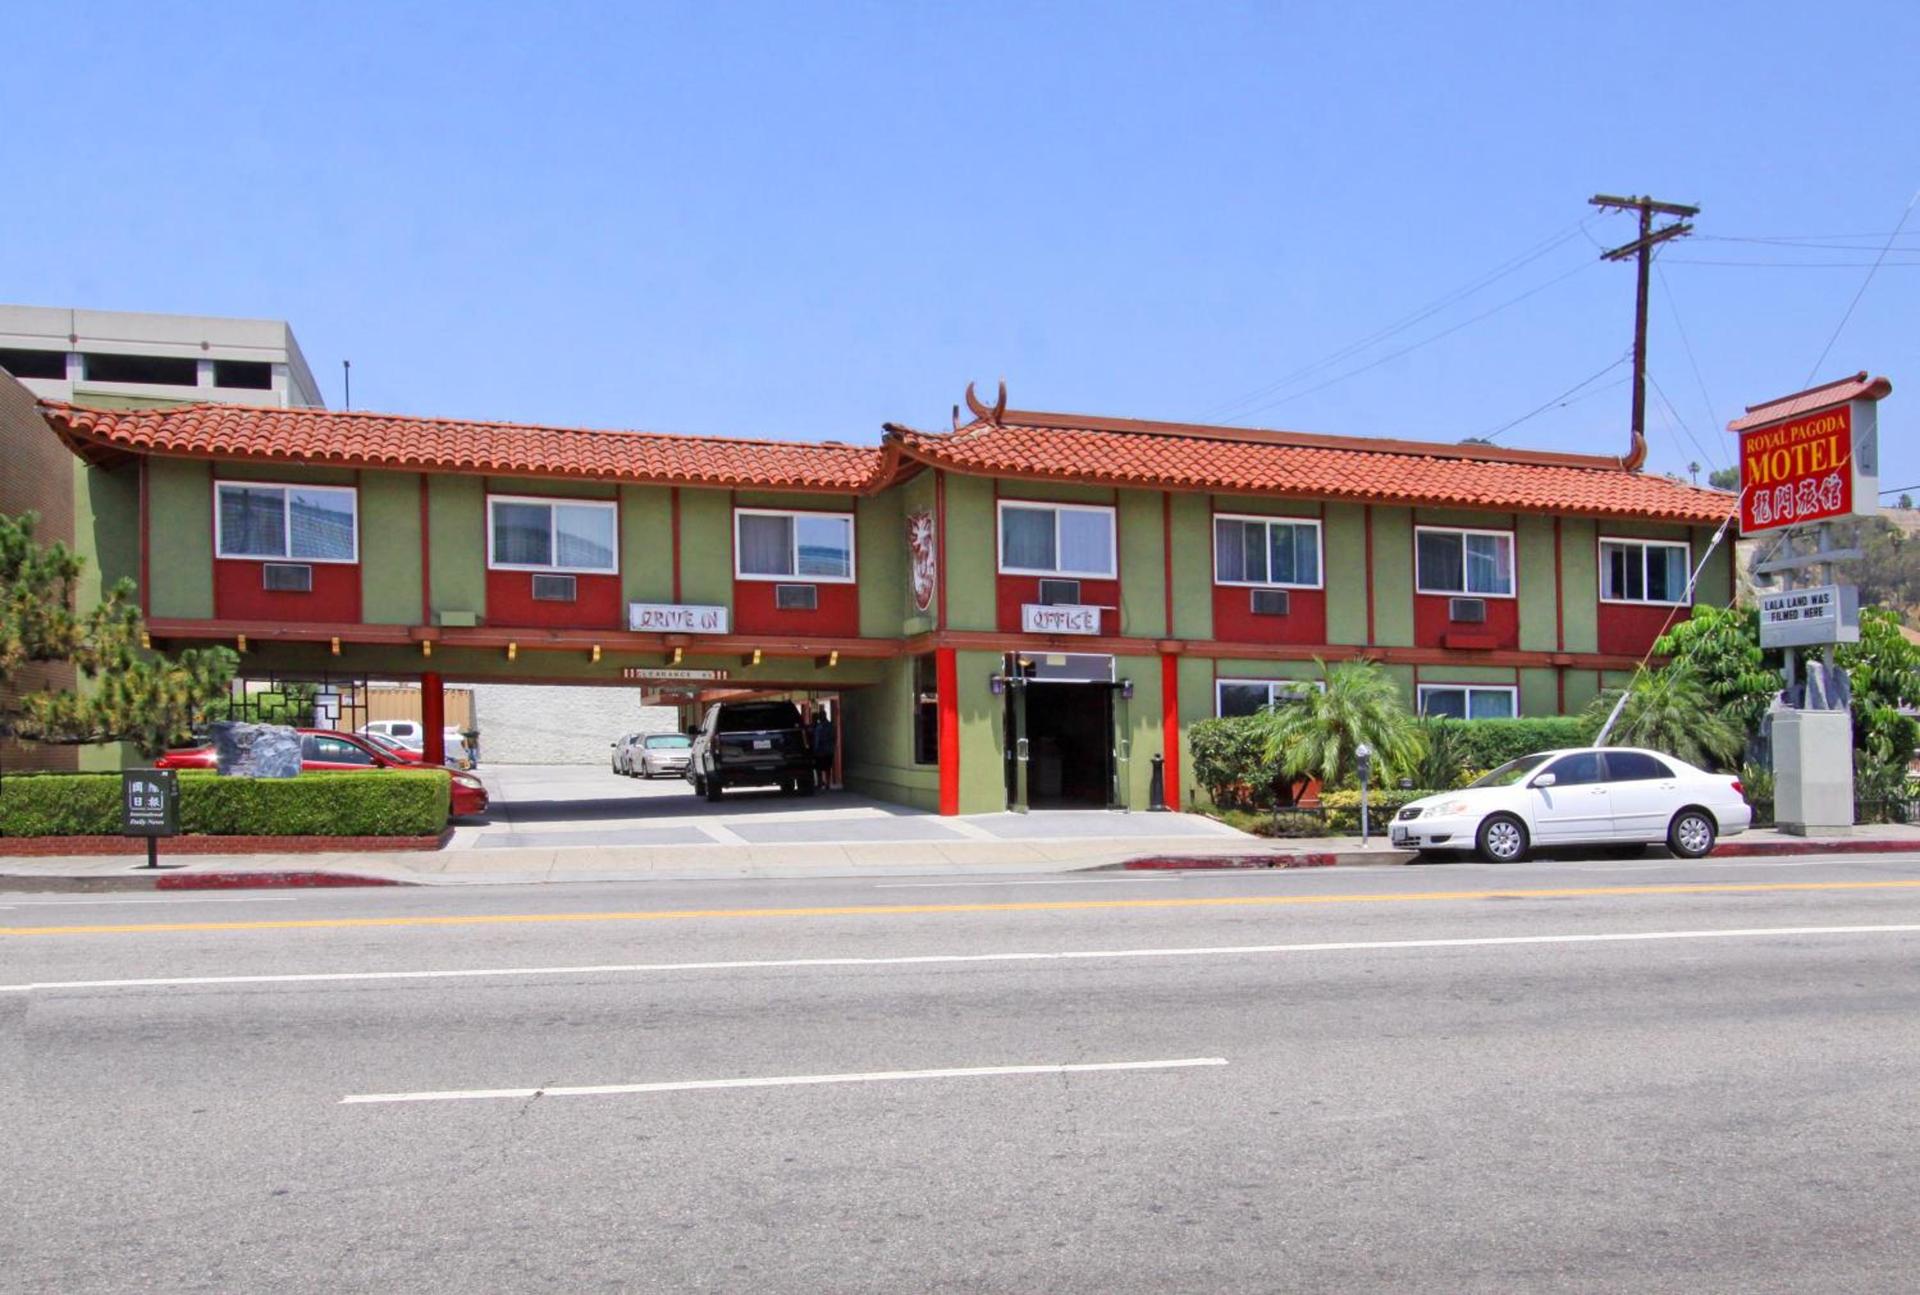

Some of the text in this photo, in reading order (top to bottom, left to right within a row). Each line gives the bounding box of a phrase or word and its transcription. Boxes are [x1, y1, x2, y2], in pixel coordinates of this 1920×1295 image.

[1747, 415, 1846, 453] ROYAL PAGODA
[1747, 435, 1840, 485] MOTEL
[1764, 593, 1829, 611] LALA LAND WAS
[641, 610, 718, 628] DRIVE IN
[1034, 610, 1094, 630] OFFICE
[1771, 606, 1823, 622] FILMED HERE
